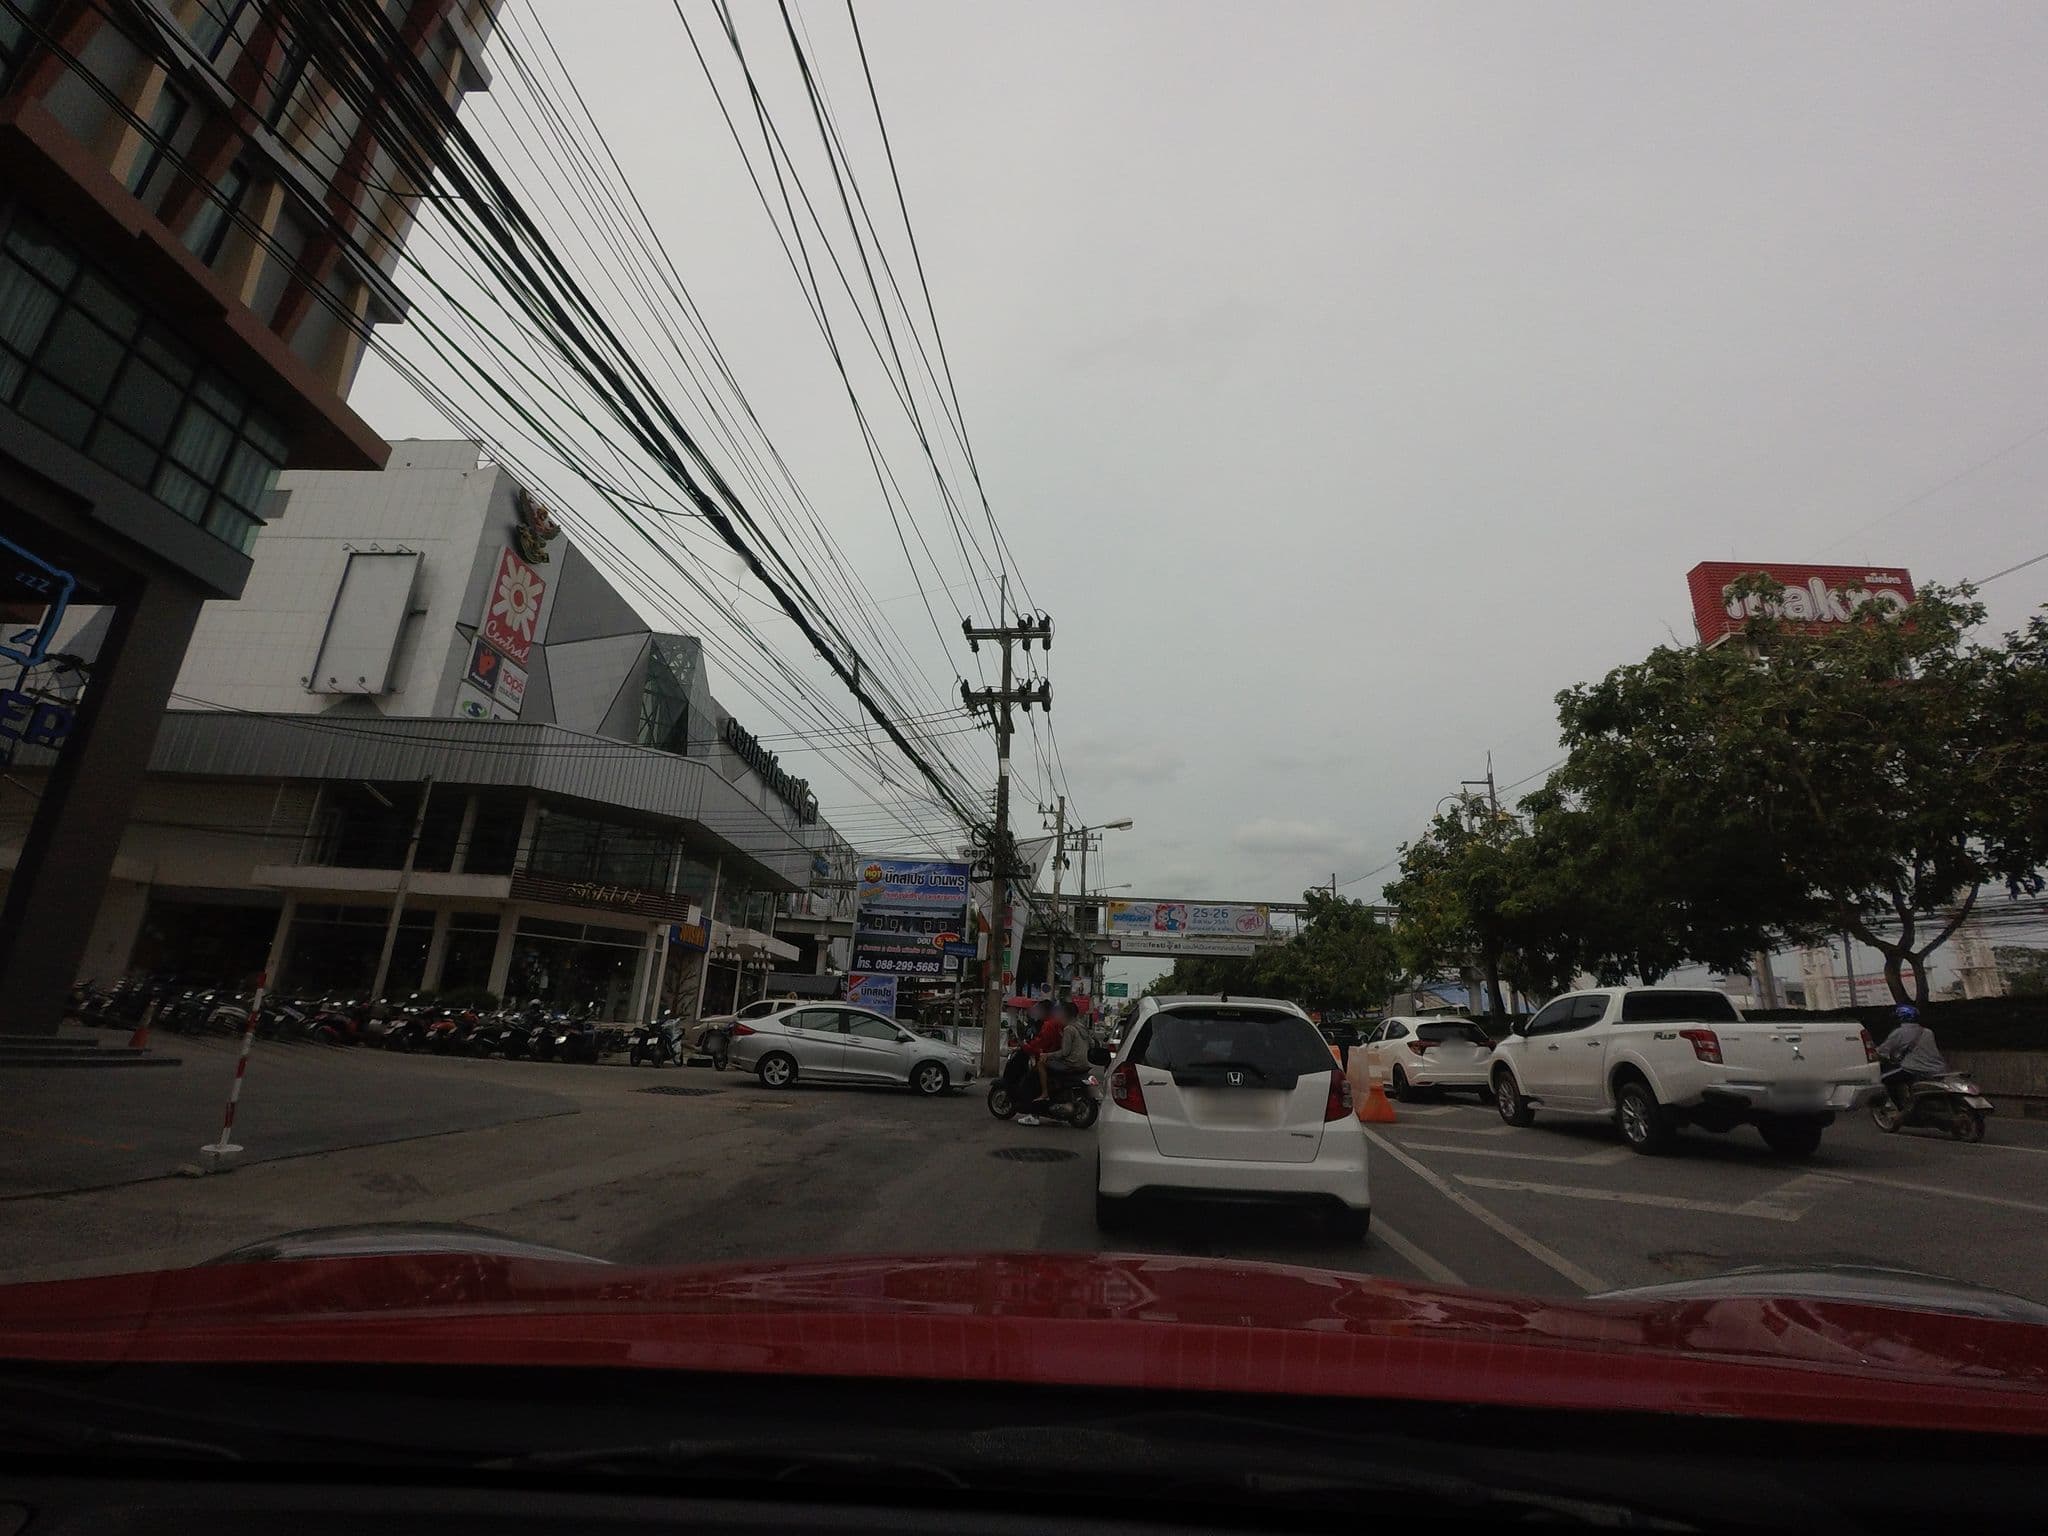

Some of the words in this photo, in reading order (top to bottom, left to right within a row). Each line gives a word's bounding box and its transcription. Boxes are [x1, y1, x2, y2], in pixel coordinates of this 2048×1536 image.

[486, 620, 529, 663] Central
[502, 668, 523, 694] Tops
[875, 959, 939, 972] 088-299-5683
